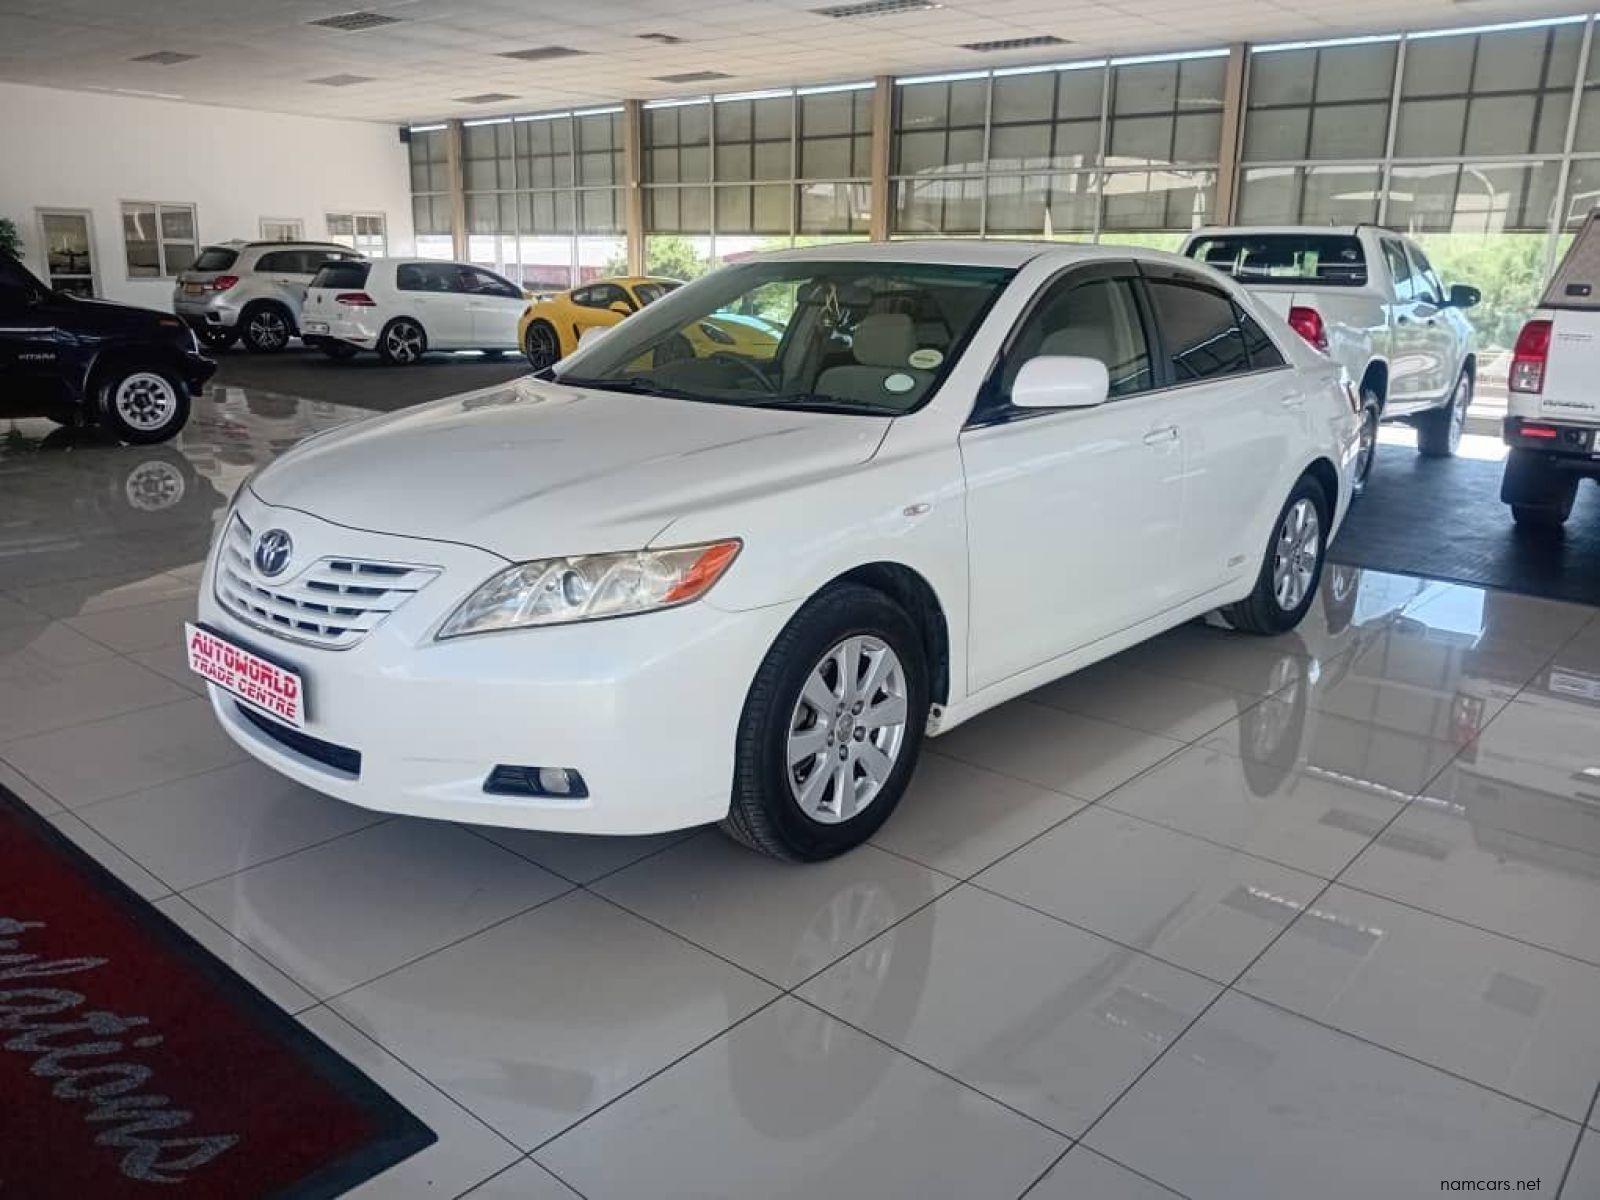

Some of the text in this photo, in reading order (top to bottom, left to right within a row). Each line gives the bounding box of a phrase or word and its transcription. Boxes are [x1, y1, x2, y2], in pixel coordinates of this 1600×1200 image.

[192, 631, 297, 698] AUTOWORLD
[193, 653, 296, 718] TRADE CENTRE
